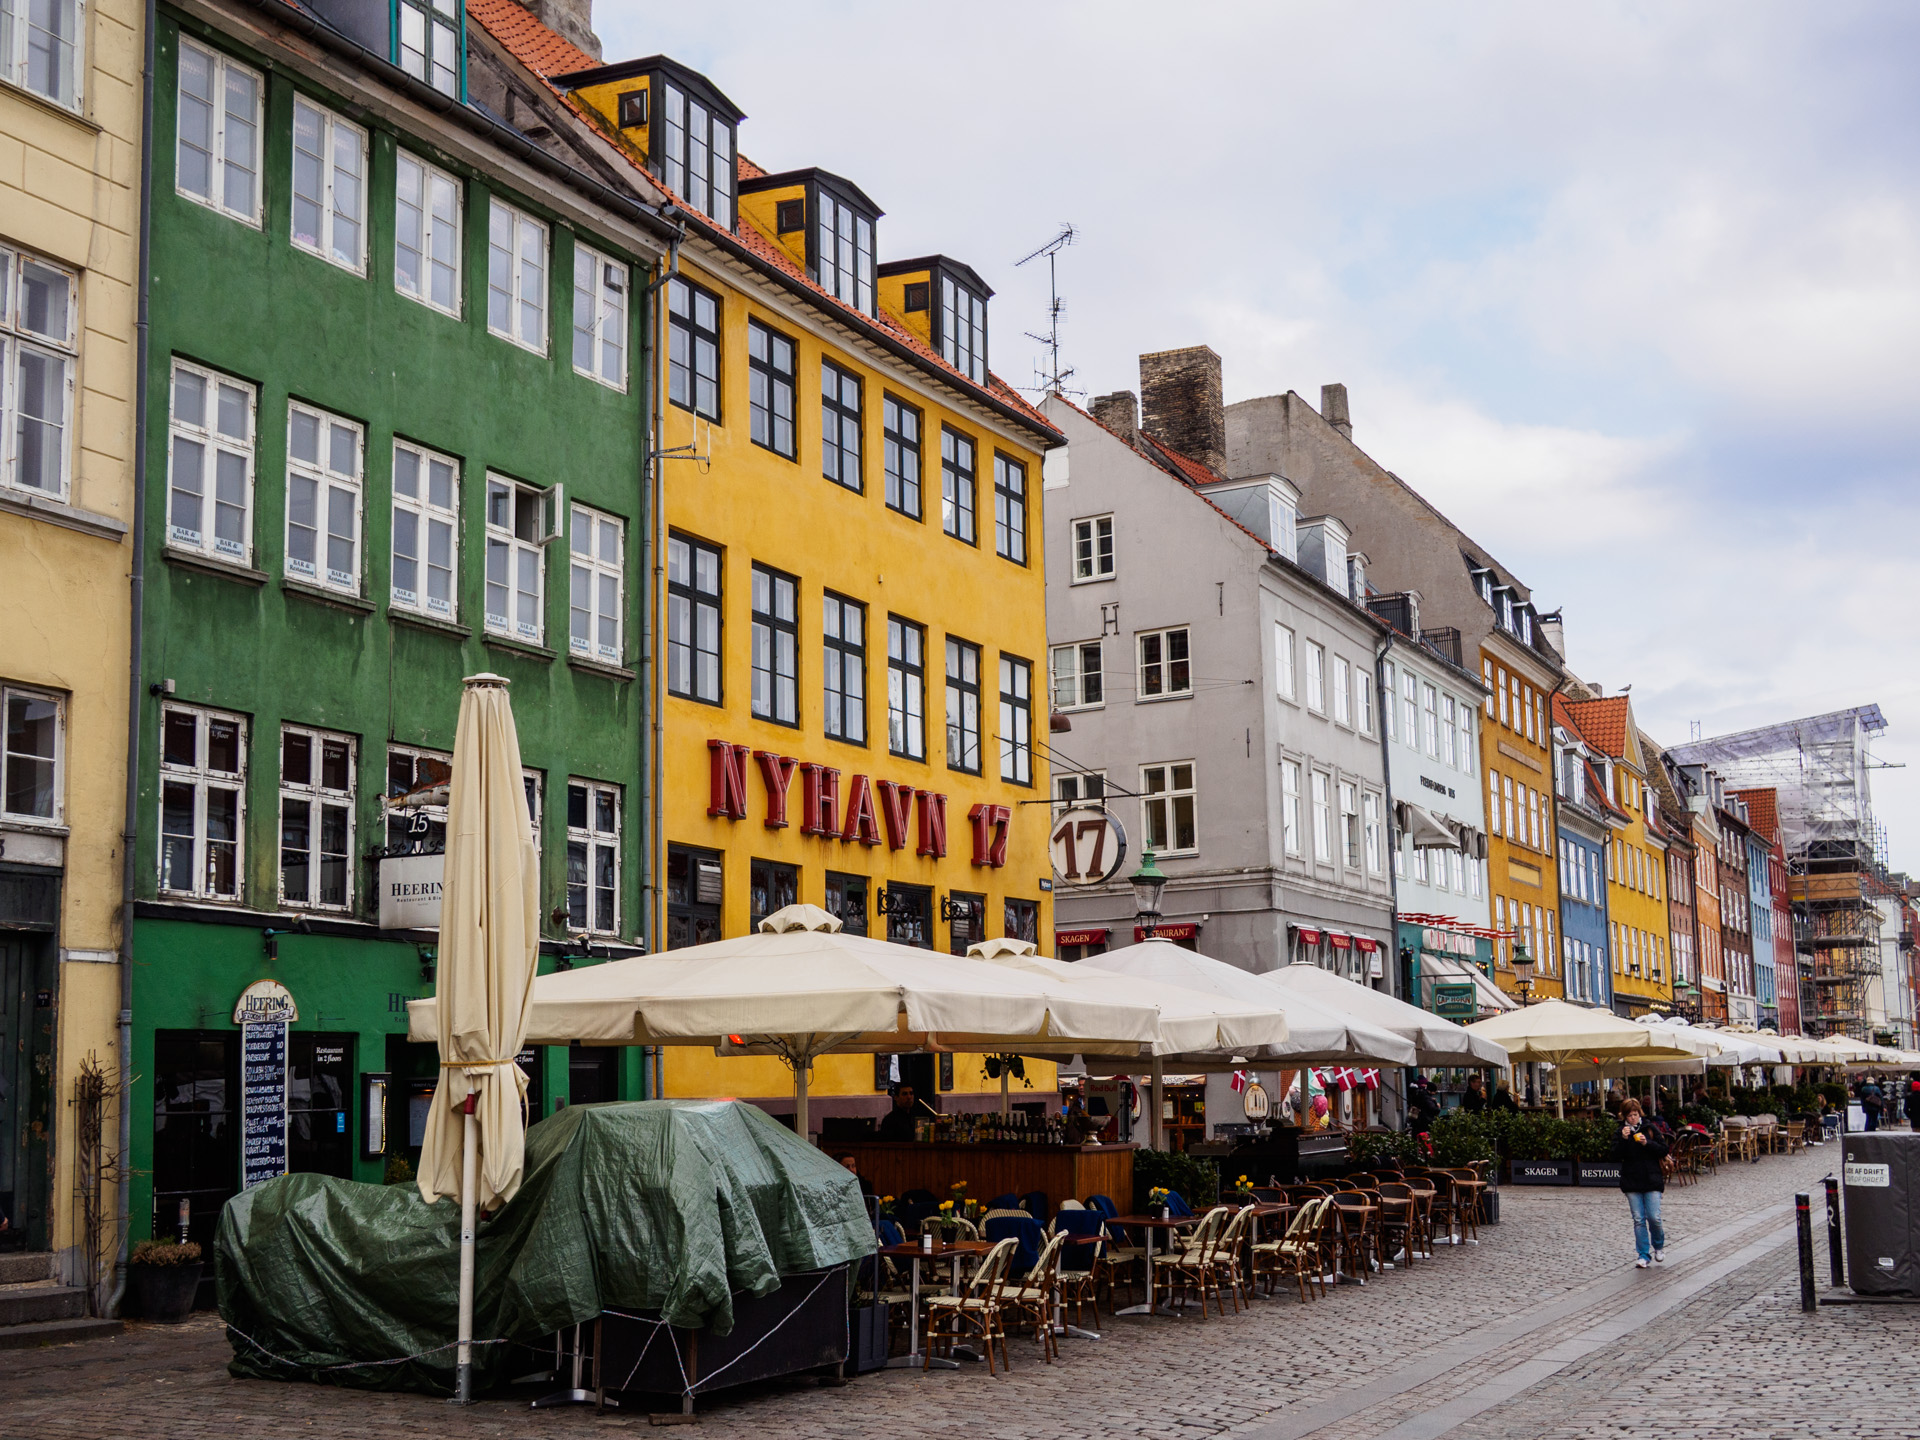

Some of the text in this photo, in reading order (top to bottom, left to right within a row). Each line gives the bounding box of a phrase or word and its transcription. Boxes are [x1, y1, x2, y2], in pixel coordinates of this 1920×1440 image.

[172, 533, 200, 544] Restaurant
[177, 528, 191, 536] BAR
[707, 739, 1012, 868] NYHAVN 17
[409, 814, 428, 832] 15
[1053, 818, 1107, 879] 17
[391, 882, 442, 896] HEERIN
[1060, 928, 1190, 944] SKAGEN RSTAURANT
[246, 994, 288, 1011] HEERING
[1437, 994, 1470, 1005] CAP HORN
[1525, 1168, 1558, 1176] SKAGEN
